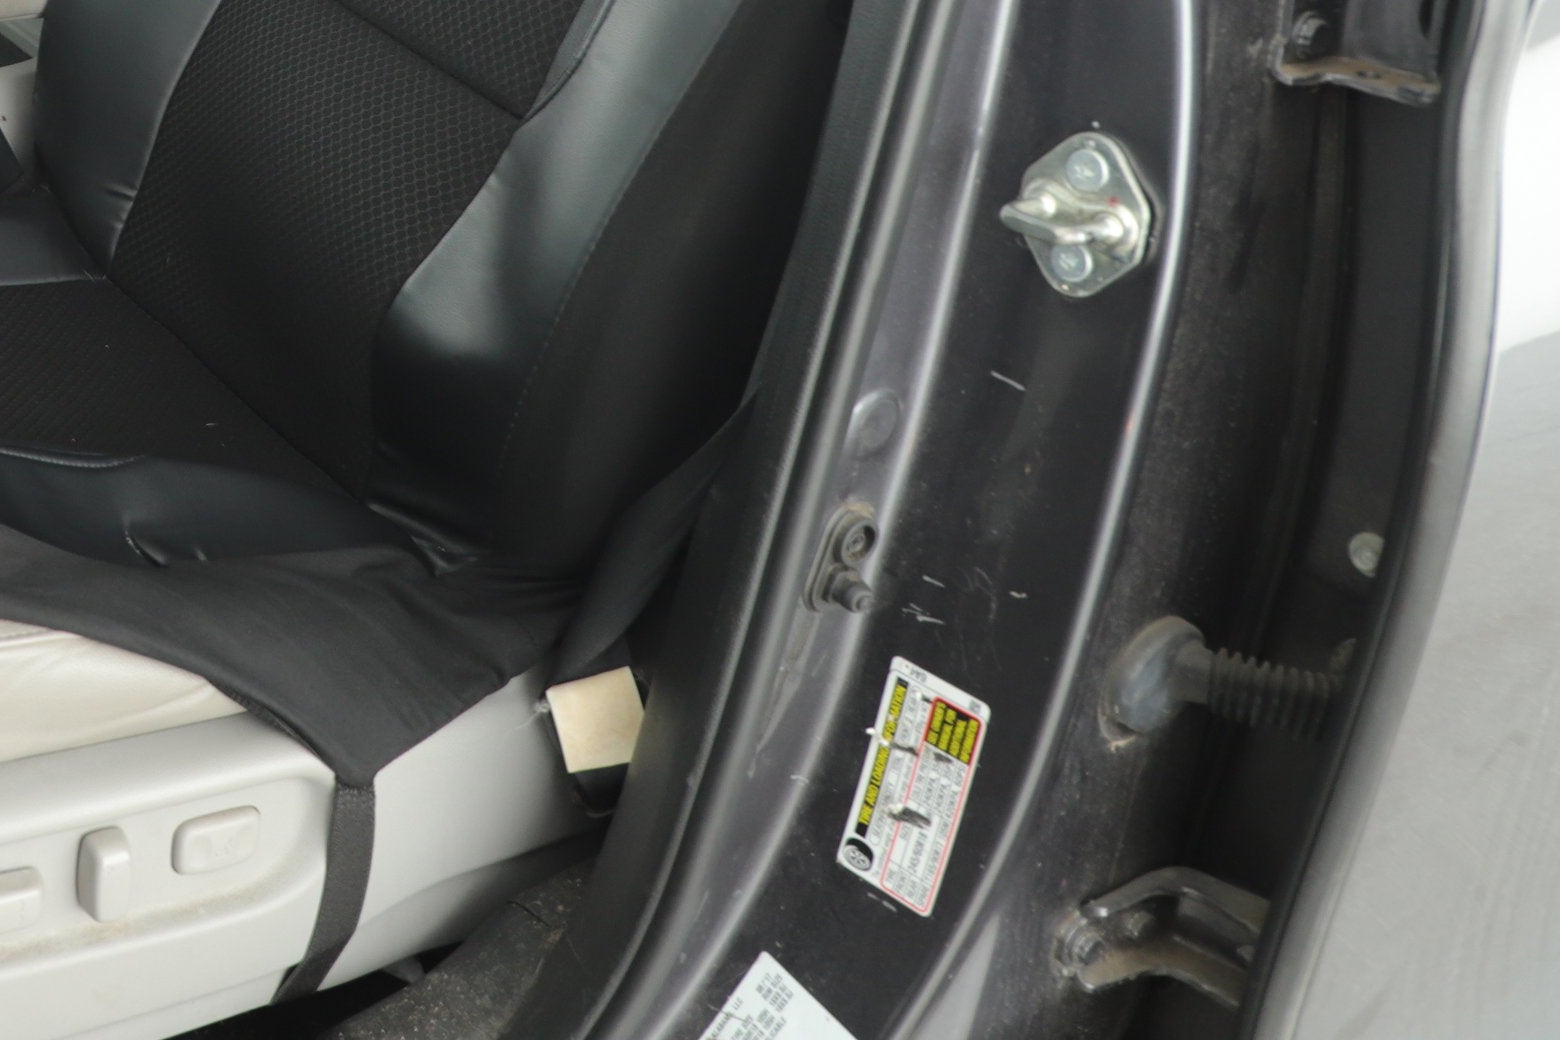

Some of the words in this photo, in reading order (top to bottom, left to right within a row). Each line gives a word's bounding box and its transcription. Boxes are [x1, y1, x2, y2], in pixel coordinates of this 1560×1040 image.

[869, 743, 890, 786] LOADING
[863, 782, 879, 806] AND
[857, 802, 873, 827] TIRE
